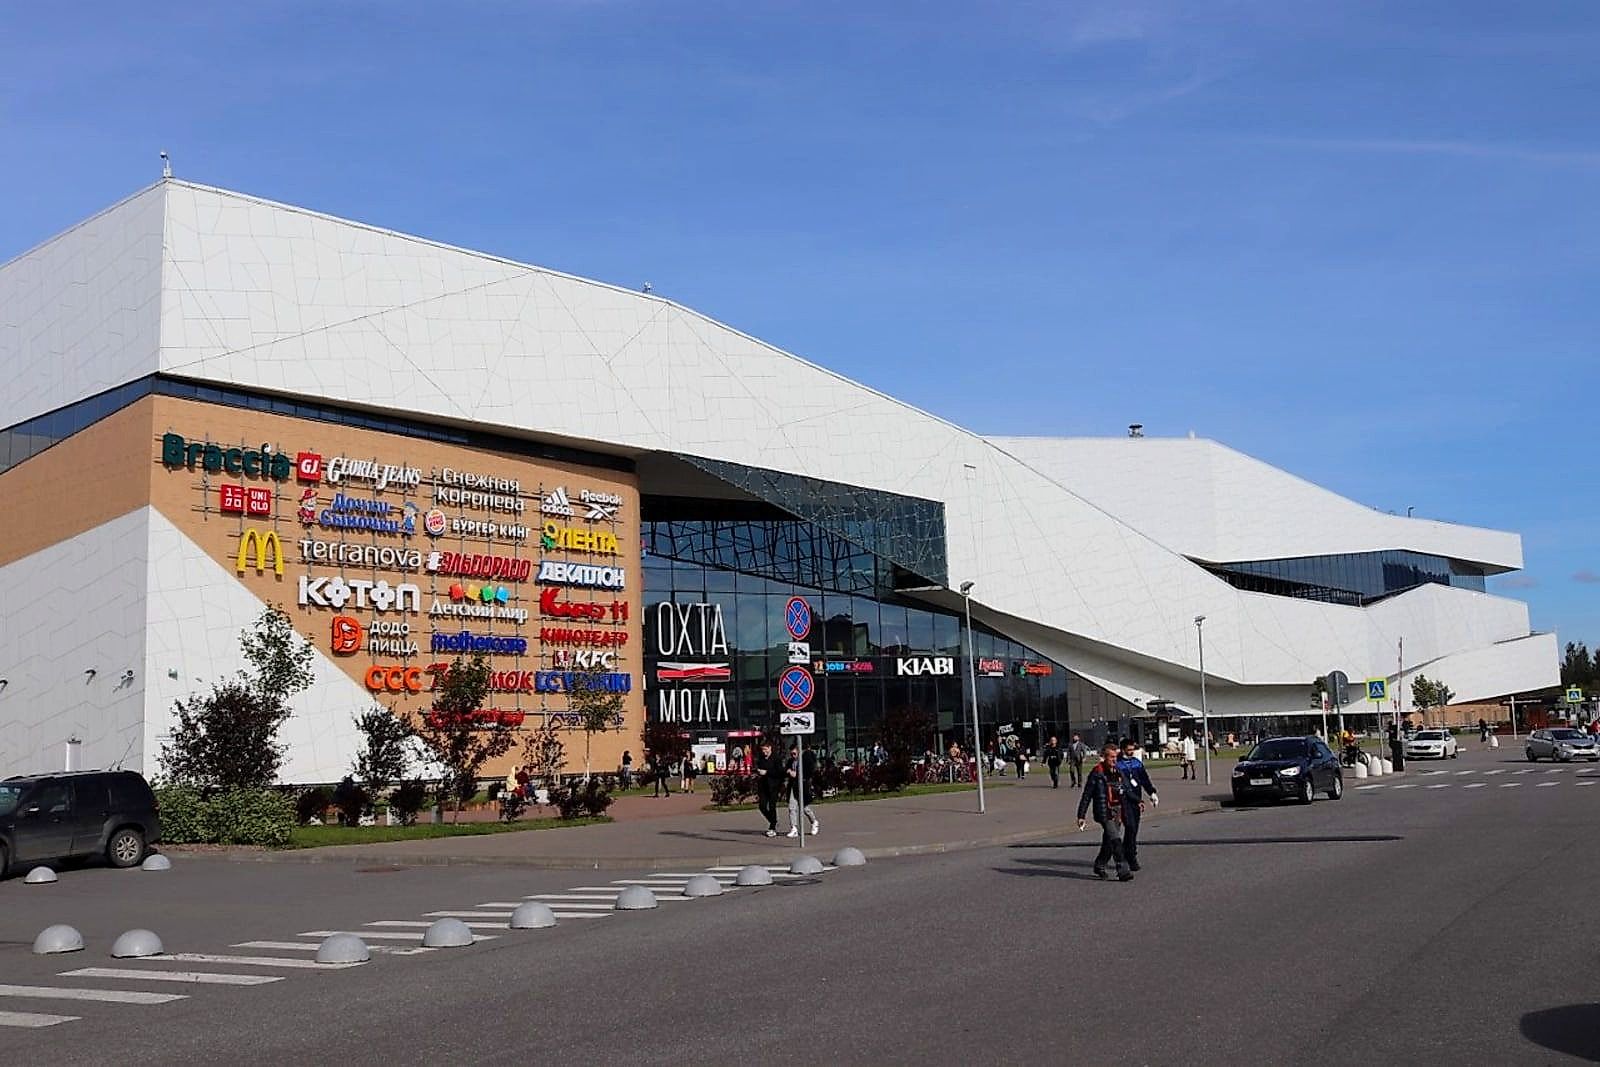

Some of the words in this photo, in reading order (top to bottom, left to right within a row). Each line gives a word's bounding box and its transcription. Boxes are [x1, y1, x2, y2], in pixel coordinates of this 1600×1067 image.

[162, 432, 290, 480] Braccia
[443, 468, 519, 491] Снежная
[452, 519, 496, 534] БУРГЕР
[499, 524, 530, 538] КИНГ
[557, 528, 621, 556] ЛЕНТА
[538, 562, 625, 588] ДЕКАТЛОН
[431, 599, 494, 617] Детский
[497, 607, 528, 624] мир
[658, 601, 728, 655] ОХТА
[370, 640, 419, 656] ПИЦЦА
[576, 650, 615, 669] KFC
[896, 657, 955, 676] KIABI
[659, 688, 729, 723] МОЛЛ
